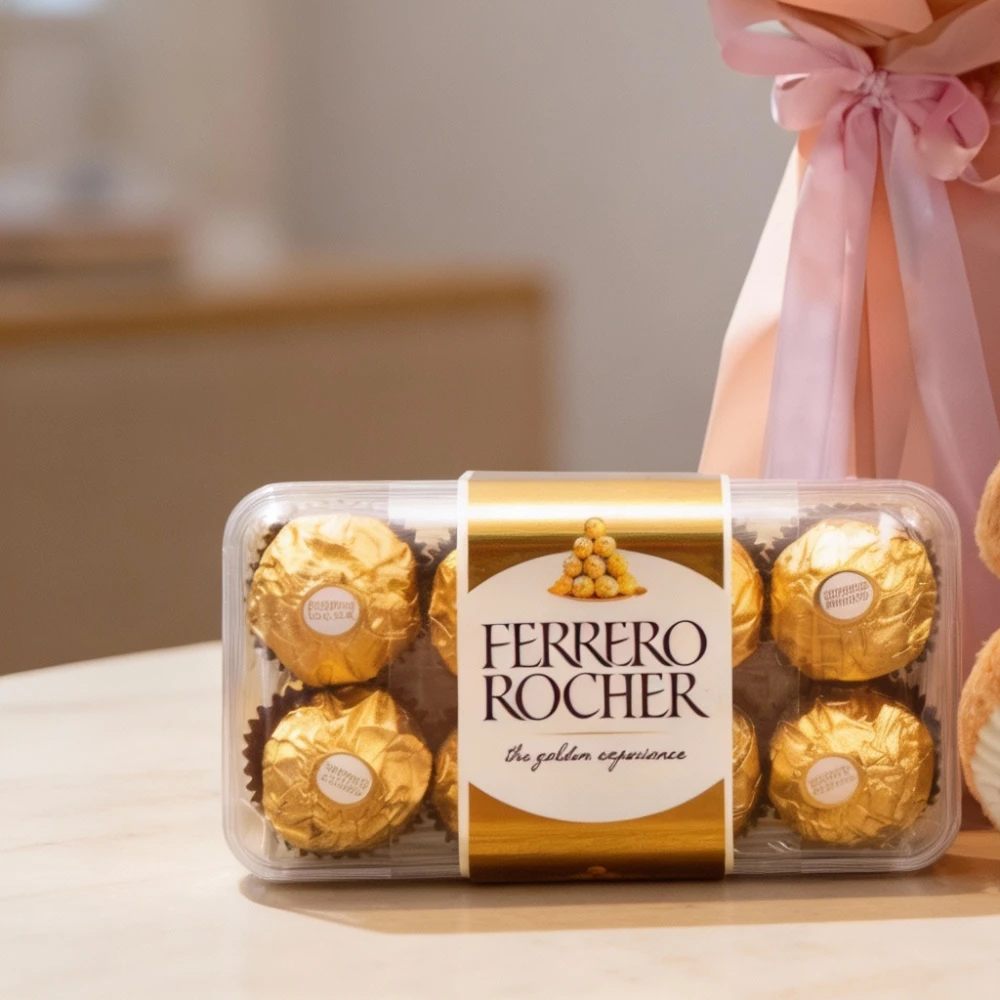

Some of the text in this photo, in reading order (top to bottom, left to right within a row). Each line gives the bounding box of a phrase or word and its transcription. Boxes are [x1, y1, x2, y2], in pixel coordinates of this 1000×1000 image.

[481, 619, 708, 670] FERRERO
[483, 672, 710, 721] ROCHER
[505, 743, 531, 763] the
